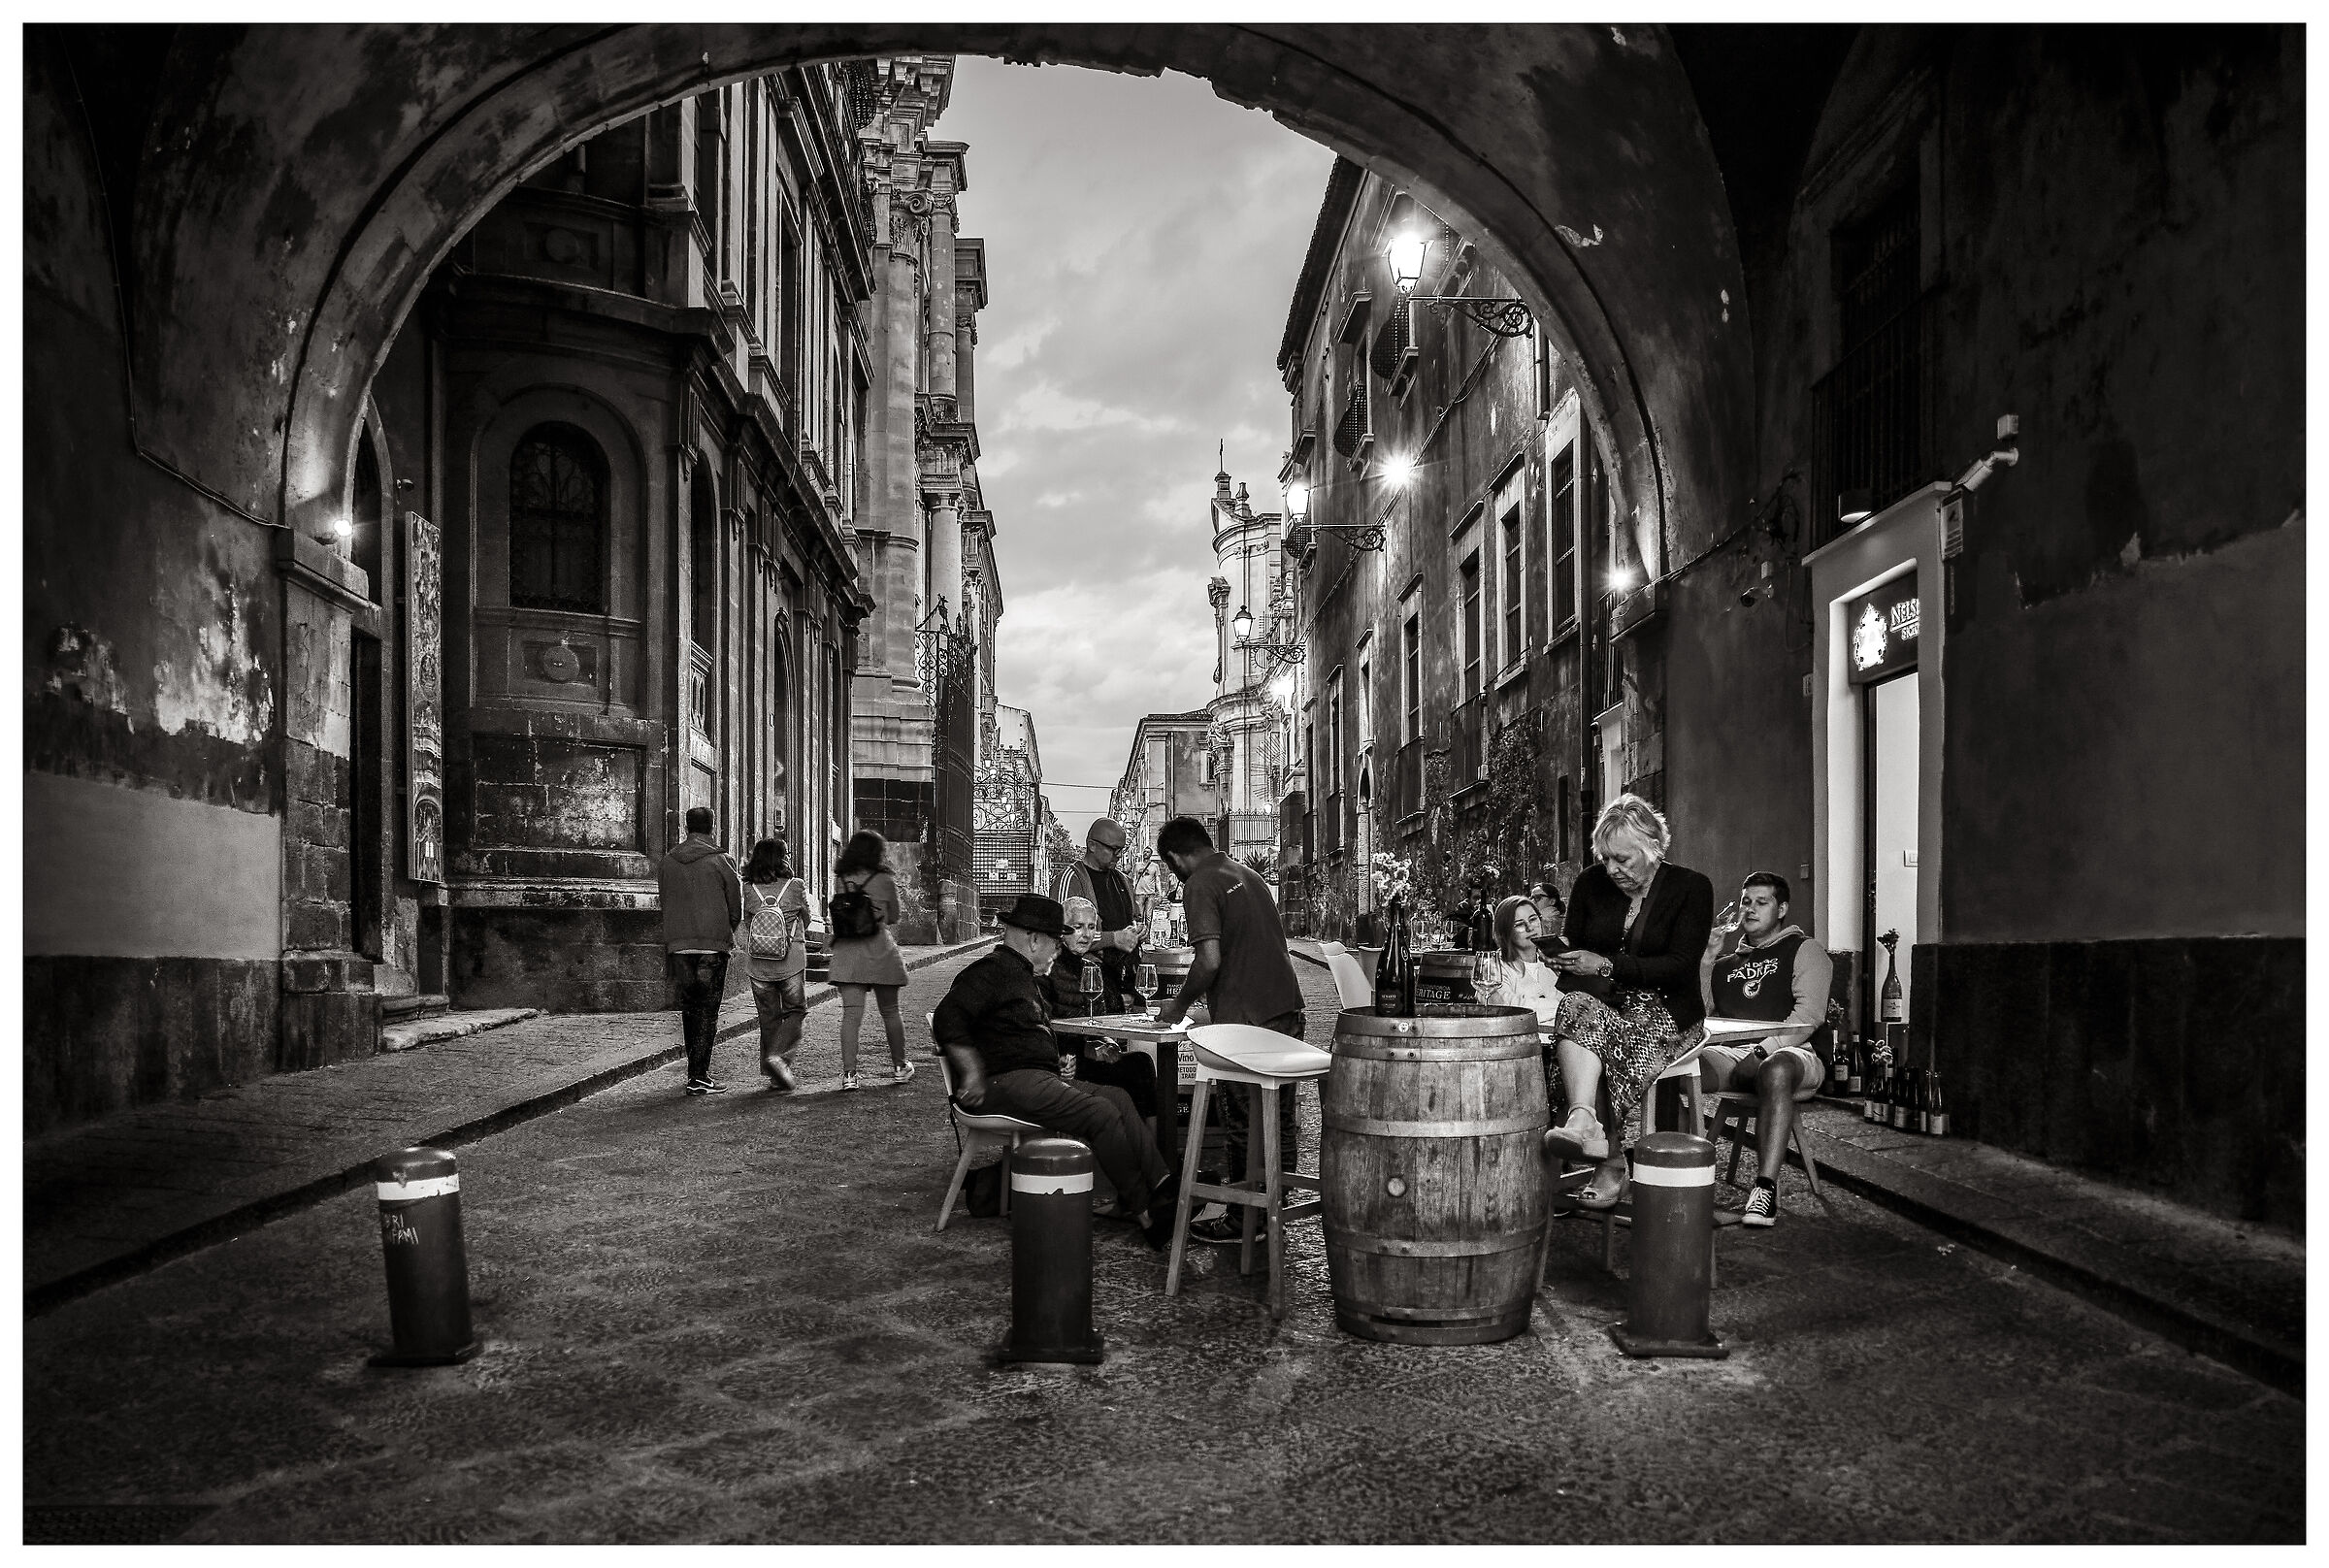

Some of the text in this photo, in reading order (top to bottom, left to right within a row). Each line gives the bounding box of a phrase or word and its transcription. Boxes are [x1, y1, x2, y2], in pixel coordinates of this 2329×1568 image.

[1726, 963, 1779, 983] PADRES
[1417, 988, 1451, 1000] ERITAGE
[1179, 1054, 1195, 1062] Vino
